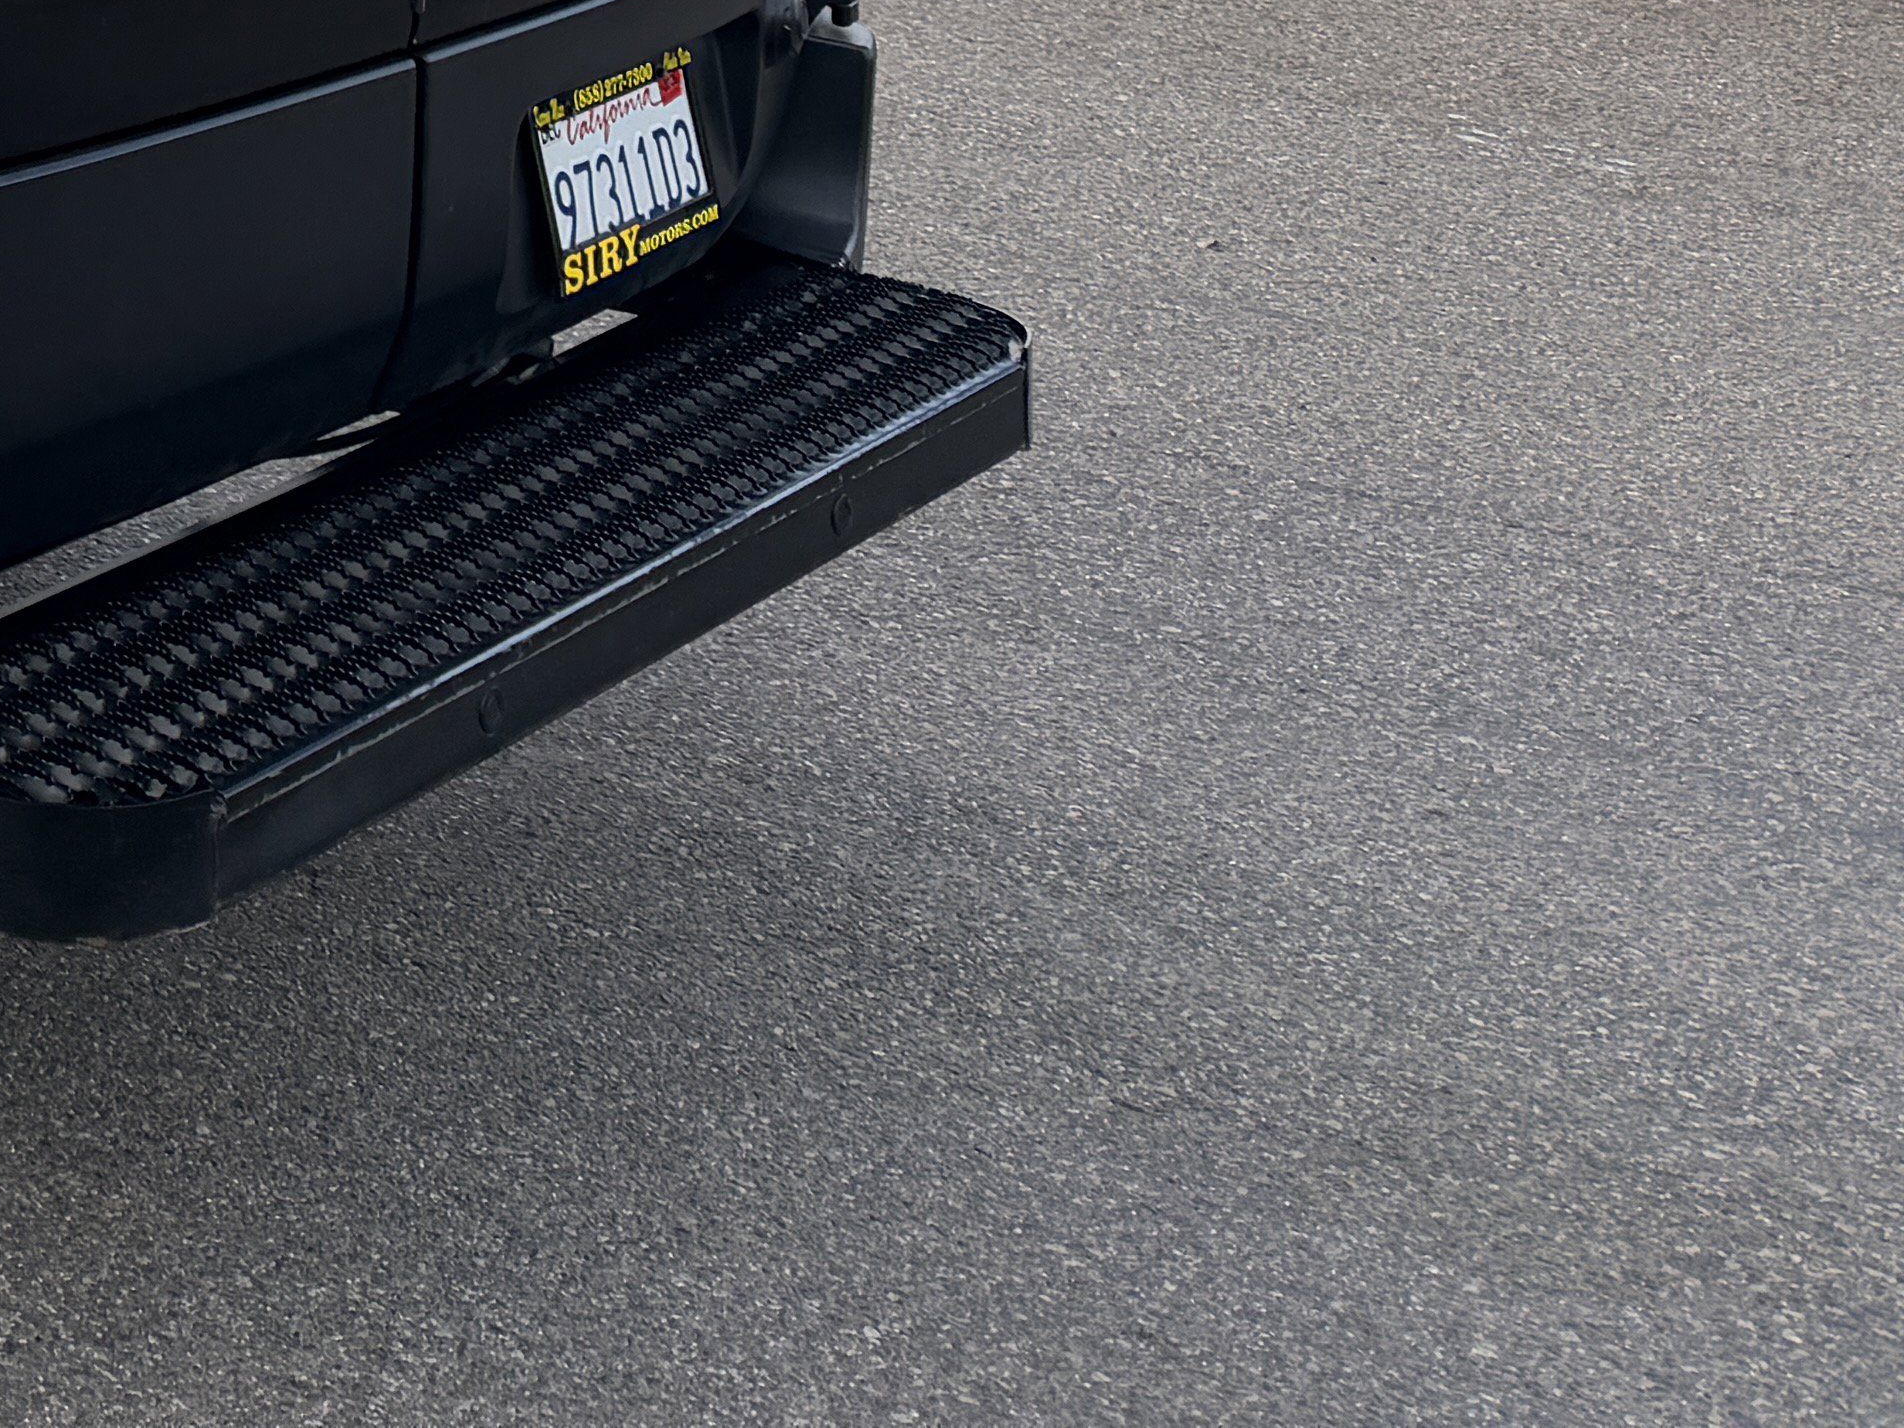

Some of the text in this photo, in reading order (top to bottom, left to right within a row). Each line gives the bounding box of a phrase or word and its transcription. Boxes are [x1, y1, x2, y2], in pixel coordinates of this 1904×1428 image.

[567, 87, 663, 145] California
[554, 118, 701, 249] 97311D3
[563, 203, 720, 295] SIRY MOTORS.COM
